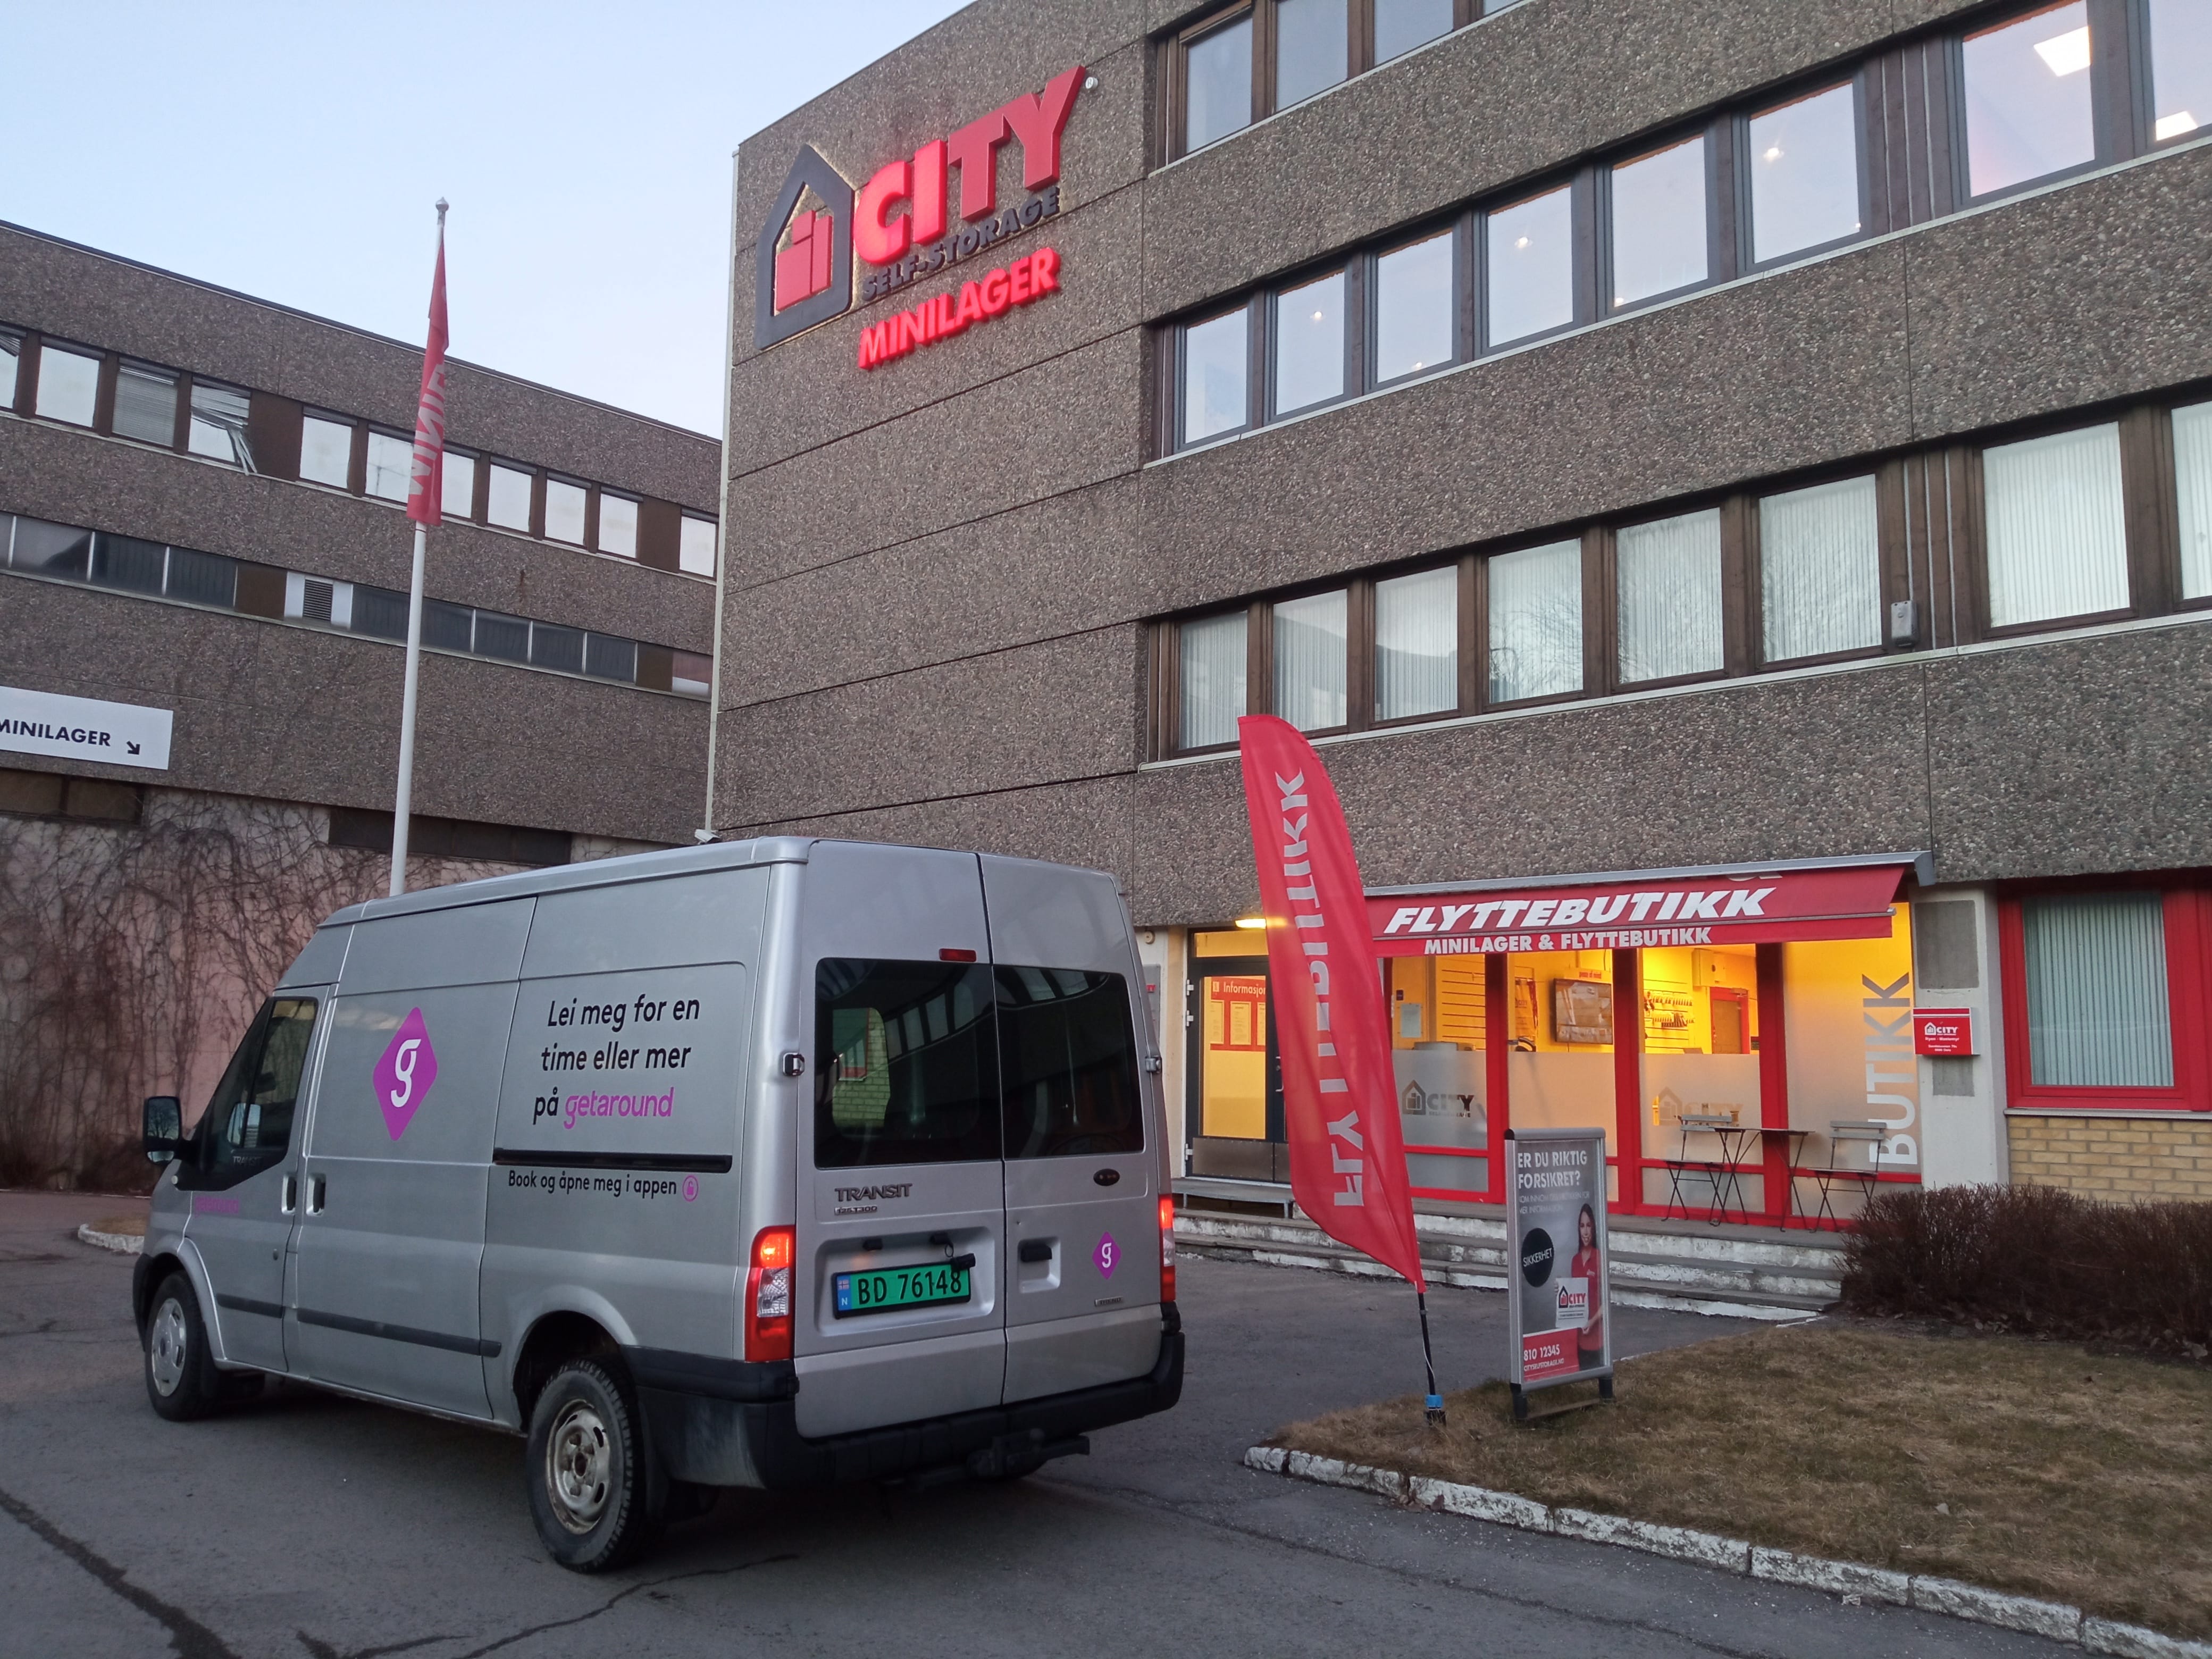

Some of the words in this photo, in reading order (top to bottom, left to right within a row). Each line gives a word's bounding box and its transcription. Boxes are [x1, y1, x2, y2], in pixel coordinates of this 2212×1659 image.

[853, 65, 1085, 264] CITY
[862, 187, 1060, 301] SELF-STORAGE
[859, 247, 1060, 369] MINILAGER
[0, 719, 111, 747] MINILAGER
[1384, 887, 1777, 934] FLYTTEBUTIKK
[1425, 935, 1532, 954] MINILAGER
[1538, 934, 1554, 950] &
[1561, 927, 1712, 949] FLYTTEBUTIKK
[548, 998, 577, 1027] Lei
[581, 1003, 626, 1032] meg
[634, 994, 667, 1023] for
[673, 998, 700, 1020] en
[541, 1043, 587, 1071] time
[593, 1041, 640, 1070] eller
[645, 1046, 691, 1069] mer
[1862, 972, 1917, 1164] BUTIKK
[390, 1039, 421, 1107] g
[533, 1087, 559, 1125] på
[563, 1087, 675, 1129] getaround
[1427, 1093, 1474, 1111] CITY
[1518, 1153, 1531, 1168] ER
[1535, 1152, 1548, 1167] DU
[1552, 1150, 1587, 1166] RIKTIG
[508, 1170, 537, 1187] Book
[540, 1175, 555, 1193] og
[559, 1171, 590, 1195] åpne
[594, 1177, 622, 1197] meg
[626, 1174, 630, 1192] i
[634, 1178, 677, 1199] appen
[834, 1183, 913, 1202] TRANSIT
[1518, 1170, 1580, 1189] FORSIKRET?
[1101, 1242, 1112, 1268] g
[1523, 1248, 1552, 1267] SIKKERHET
[842, 1297, 848, 1305] N
[858, 1277, 887, 1304] BD
[898, 1270, 961, 1300] 76148
[1569, 1293, 1586, 1304] CITY
[1523, 1348, 1537, 1361] 810
[1540, 1344, 1560, 1358] 12345
